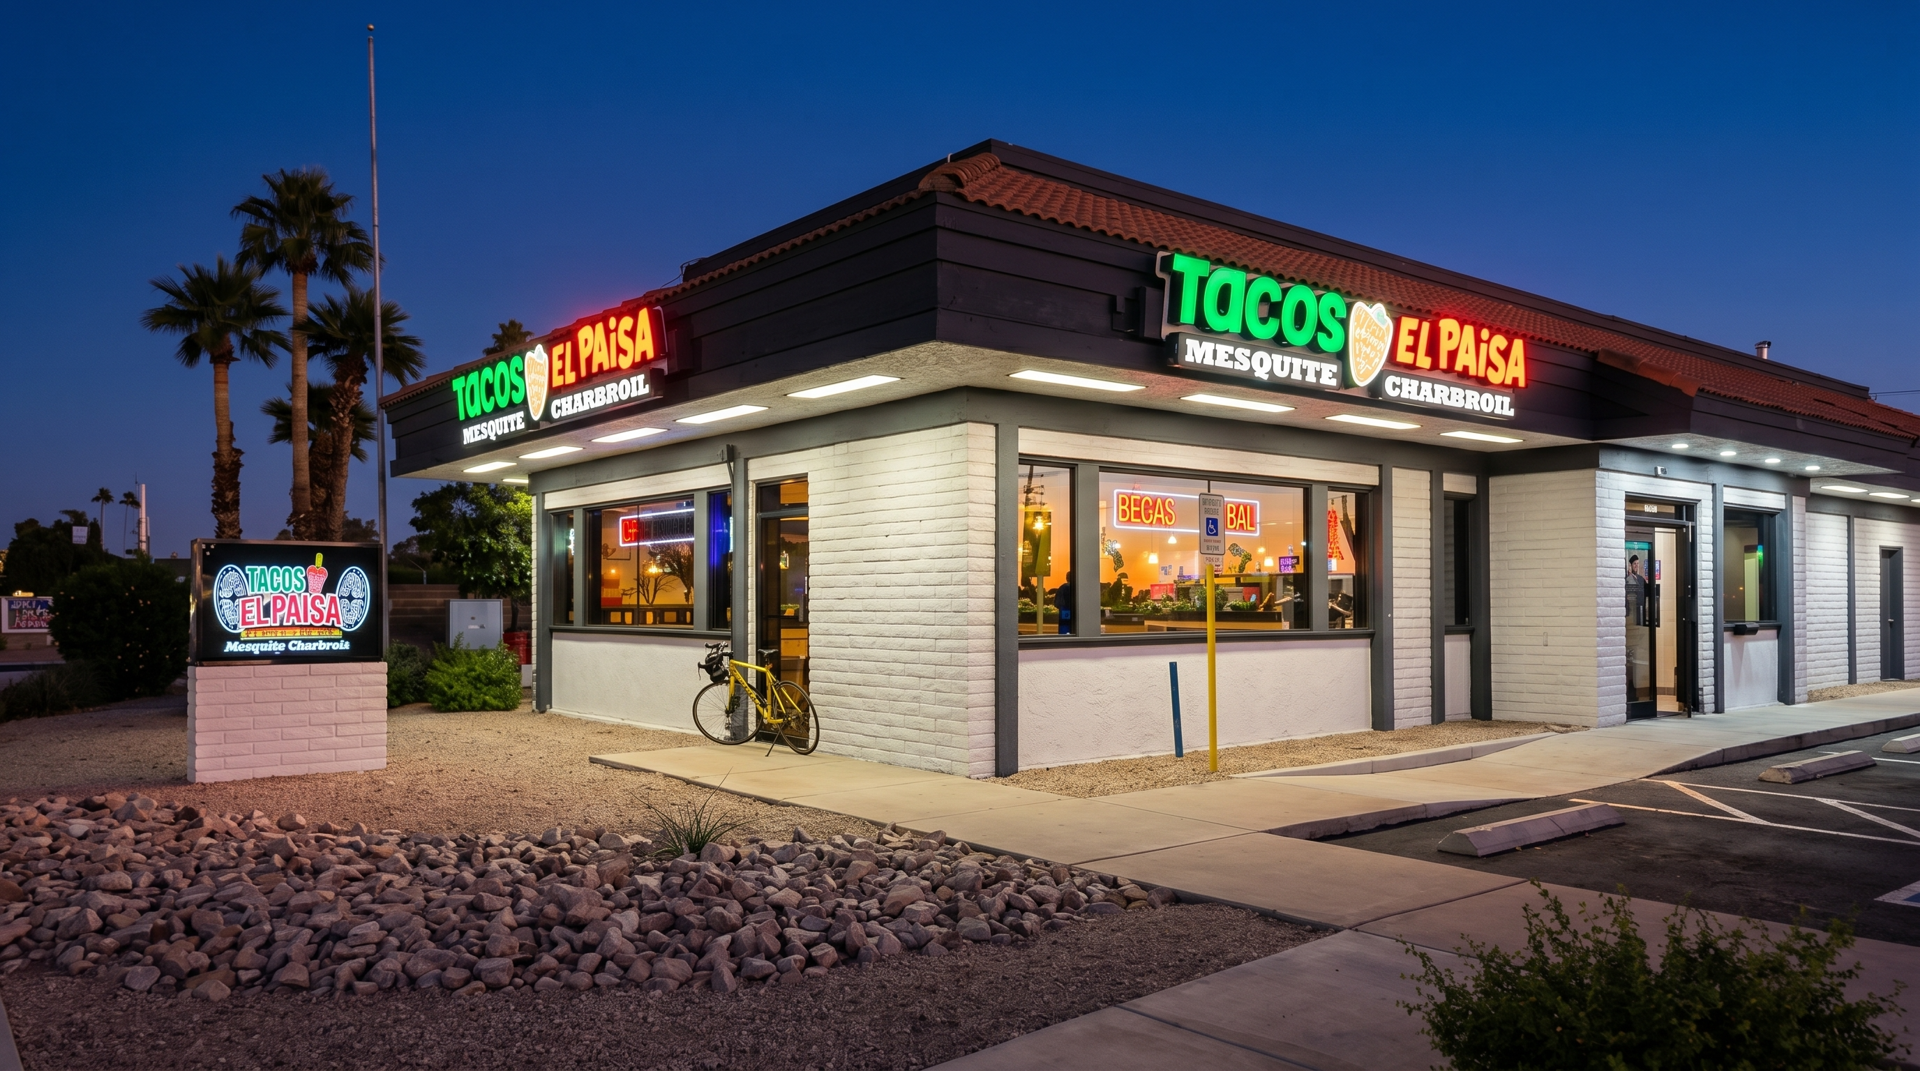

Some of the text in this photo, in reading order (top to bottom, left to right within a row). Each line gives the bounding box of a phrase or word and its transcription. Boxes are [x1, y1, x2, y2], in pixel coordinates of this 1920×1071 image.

[1185, 338, 1338, 387] MESQUITE
[1396, 316, 1432, 369] EL
[552, 341, 577, 388] EL
[551, 374, 650, 419] CHARBROIL
[1384, 374, 1515, 417] CHARBROIL
[462, 411, 526, 445] MESQUITE
[246, 566, 306, 593] TACOS
[239, 593, 344, 629] EL PAISA
[224, 641, 285, 654] Mesquite
